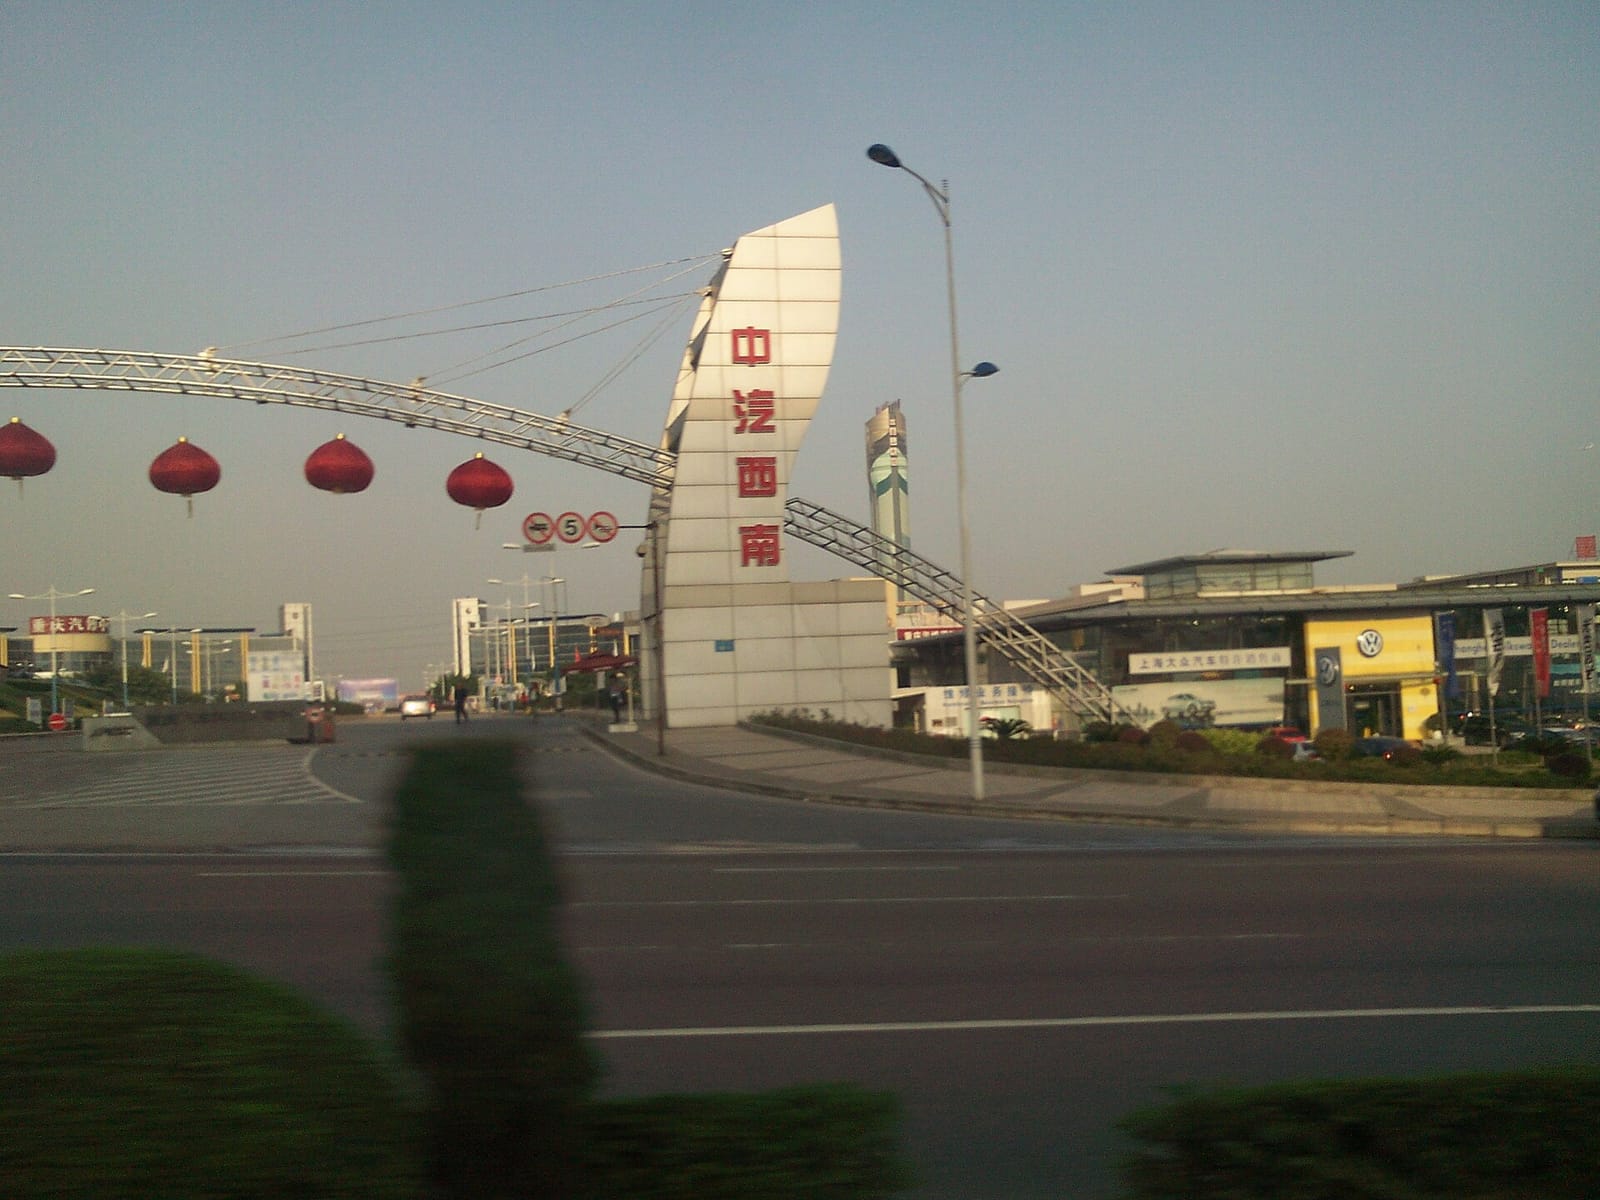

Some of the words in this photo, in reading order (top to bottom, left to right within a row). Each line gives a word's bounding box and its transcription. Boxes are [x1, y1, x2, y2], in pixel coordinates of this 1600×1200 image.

[731, 326, 780, 568] 中汽西南
[564, 519, 578, 537] 5
